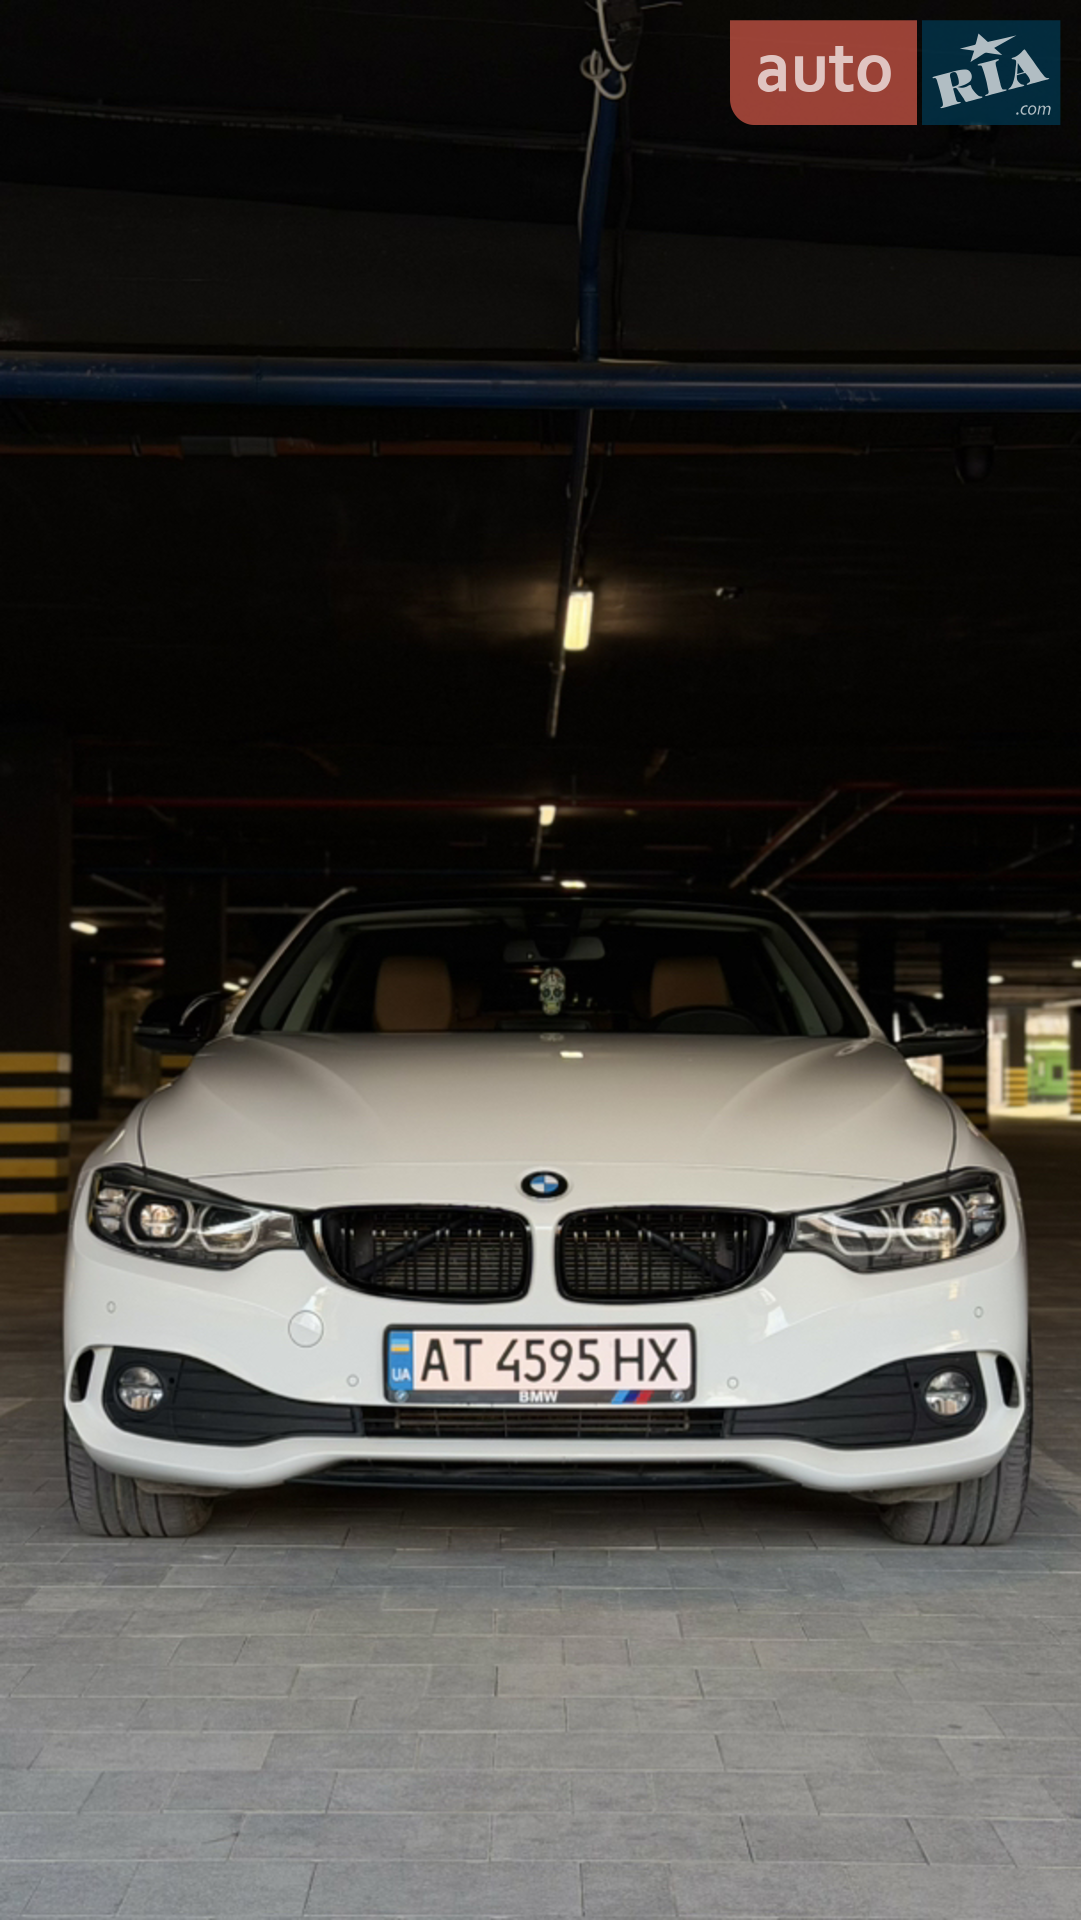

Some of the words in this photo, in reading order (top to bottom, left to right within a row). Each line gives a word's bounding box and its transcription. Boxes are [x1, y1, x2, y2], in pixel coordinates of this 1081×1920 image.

[421, 1338, 483, 1382] AT
[496, 1338, 600, 1383] 4595
[614, 1338, 678, 1382] HX
[391, 1368, 411, 1382] UA
[518, 1391, 559, 1403] BMW
